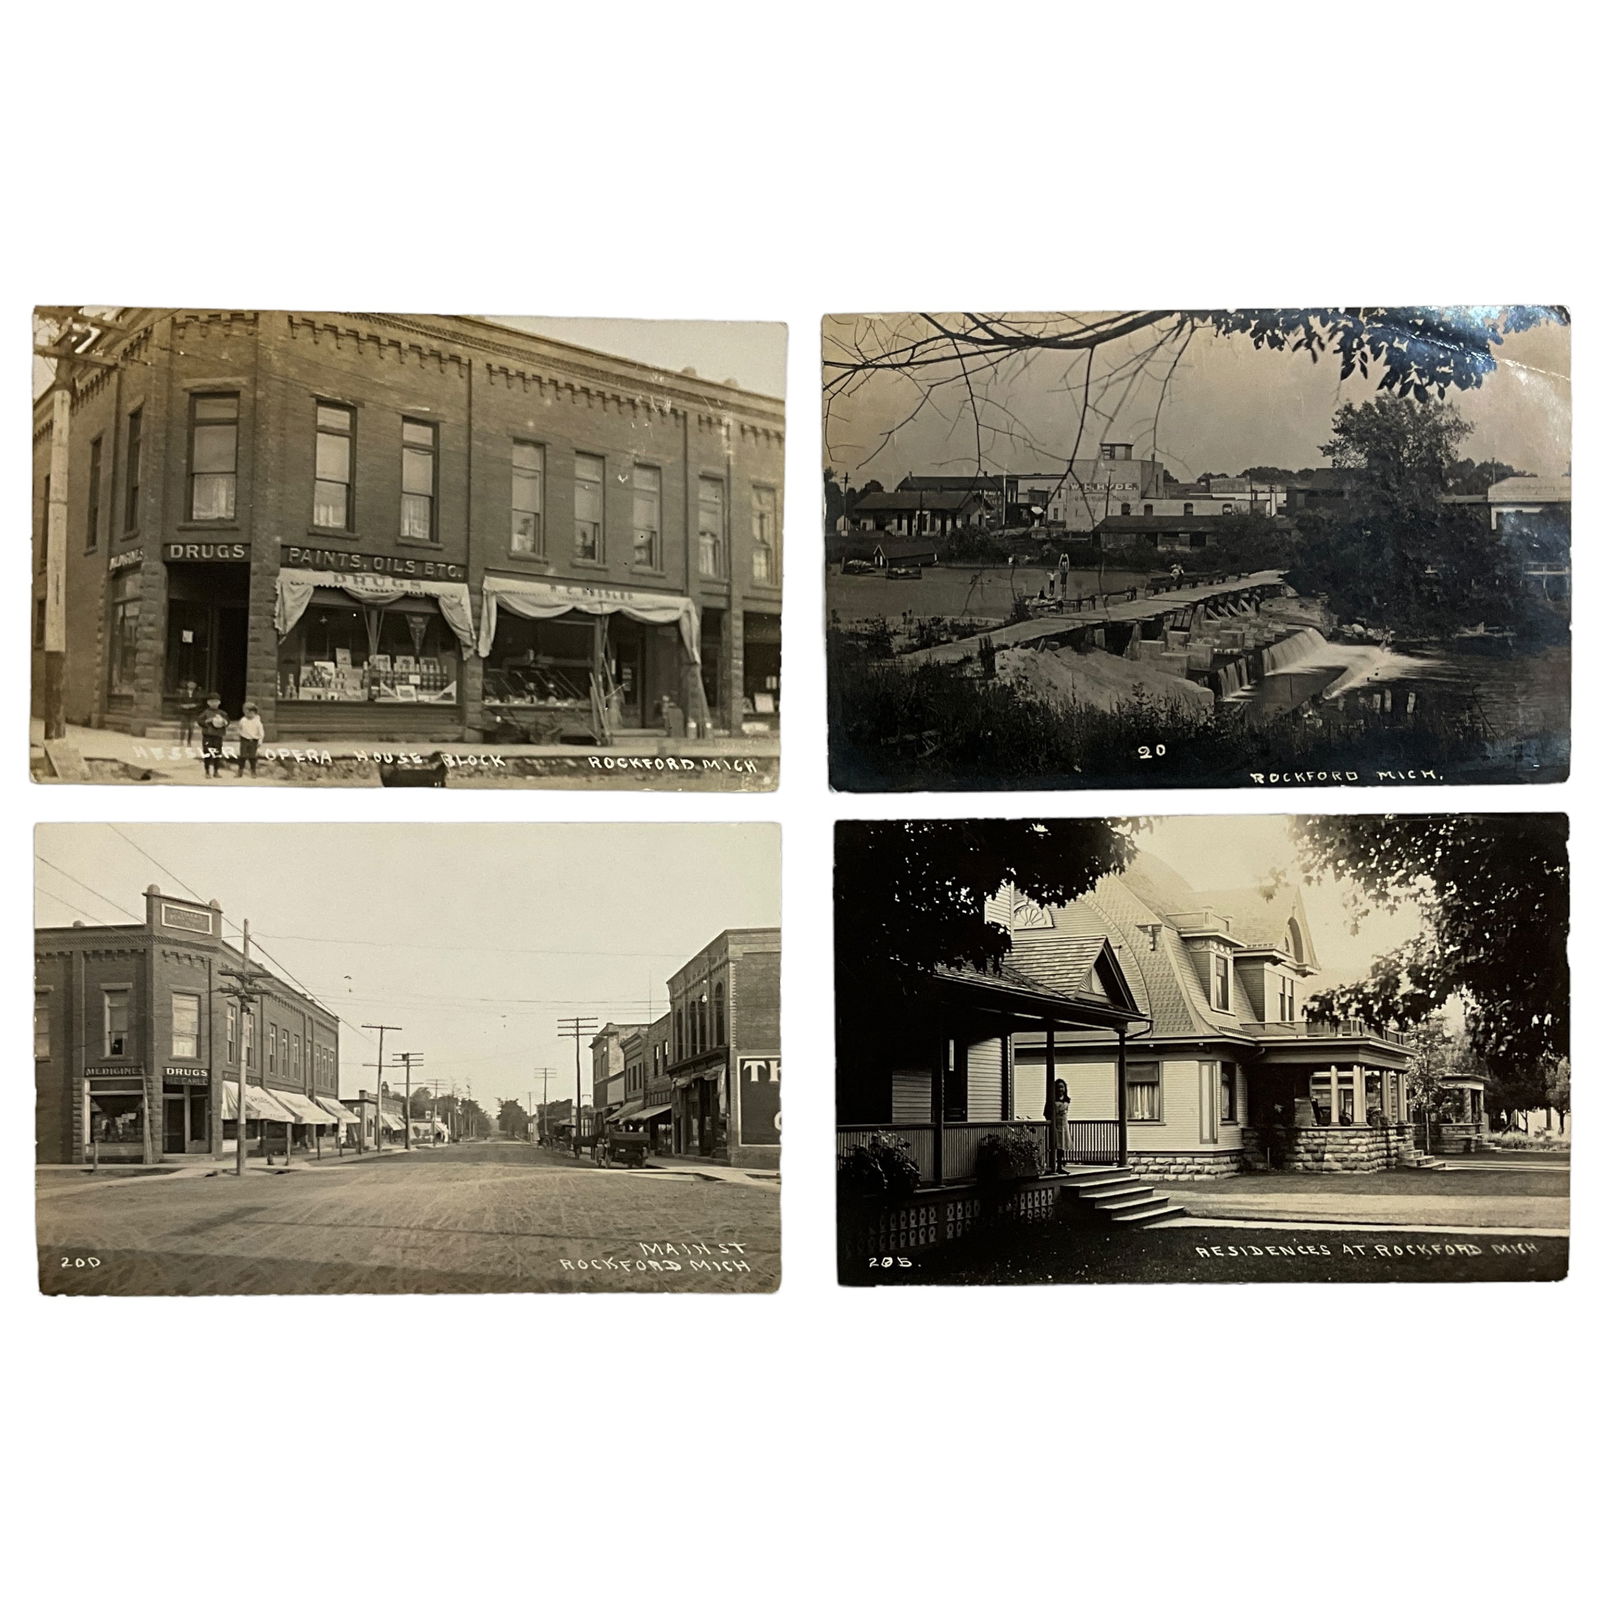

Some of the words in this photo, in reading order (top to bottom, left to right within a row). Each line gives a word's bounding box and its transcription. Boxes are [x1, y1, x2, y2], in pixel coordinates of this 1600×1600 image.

[170, 544, 246, 559] DRUGS
[373, 556, 416, 574] OILS
[423, 562, 463, 578] ETC.
[1138, 744, 1166, 759] 20
[264, 748, 333, 765] OPERA
[353, 750, 423, 764] HOUSE
[441, 753, 506, 767] BLOCK
[588, 756, 695, 771] ROCKFORD
[702, 759, 758, 773] MICH
[1250, 771, 1359, 784] ROCKFORD
[166, 1066, 209, 1078] DRUGS
[639, 1242, 712, 1256] MAIN
[718, 1243, 747, 1254] ST
[1195, 1244, 1332, 1258] RESIDENCES
[1342, 1243, 1366, 1256] AT
[1374, 1244, 1483, 1258] ROCKFORD
[1491, 1242, 1540, 1254] MICH
[560, 1257, 682, 1273] ROCKFORD
[690, 1259, 751, 1273] MICH
